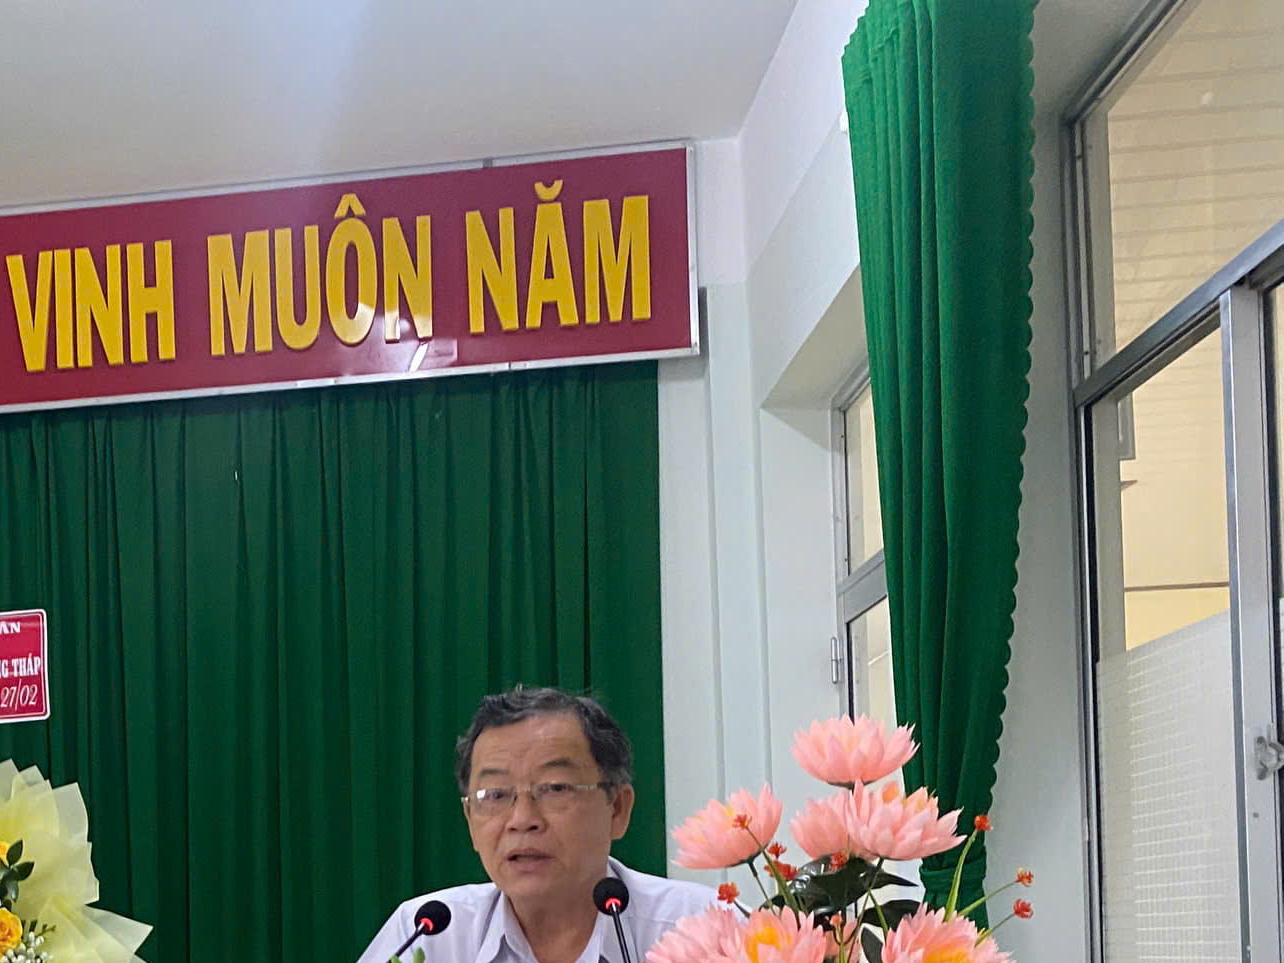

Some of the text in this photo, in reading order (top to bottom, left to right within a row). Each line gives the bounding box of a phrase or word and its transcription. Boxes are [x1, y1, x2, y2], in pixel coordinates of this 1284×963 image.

[5, 240, 176, 372] VINH
[207, 193, 433, 357] MUÔN
[465, 179, 652, 334] NĂM
[12, 652, 41, 677] THÁP
[0, 679, 38, 711] 27/02
